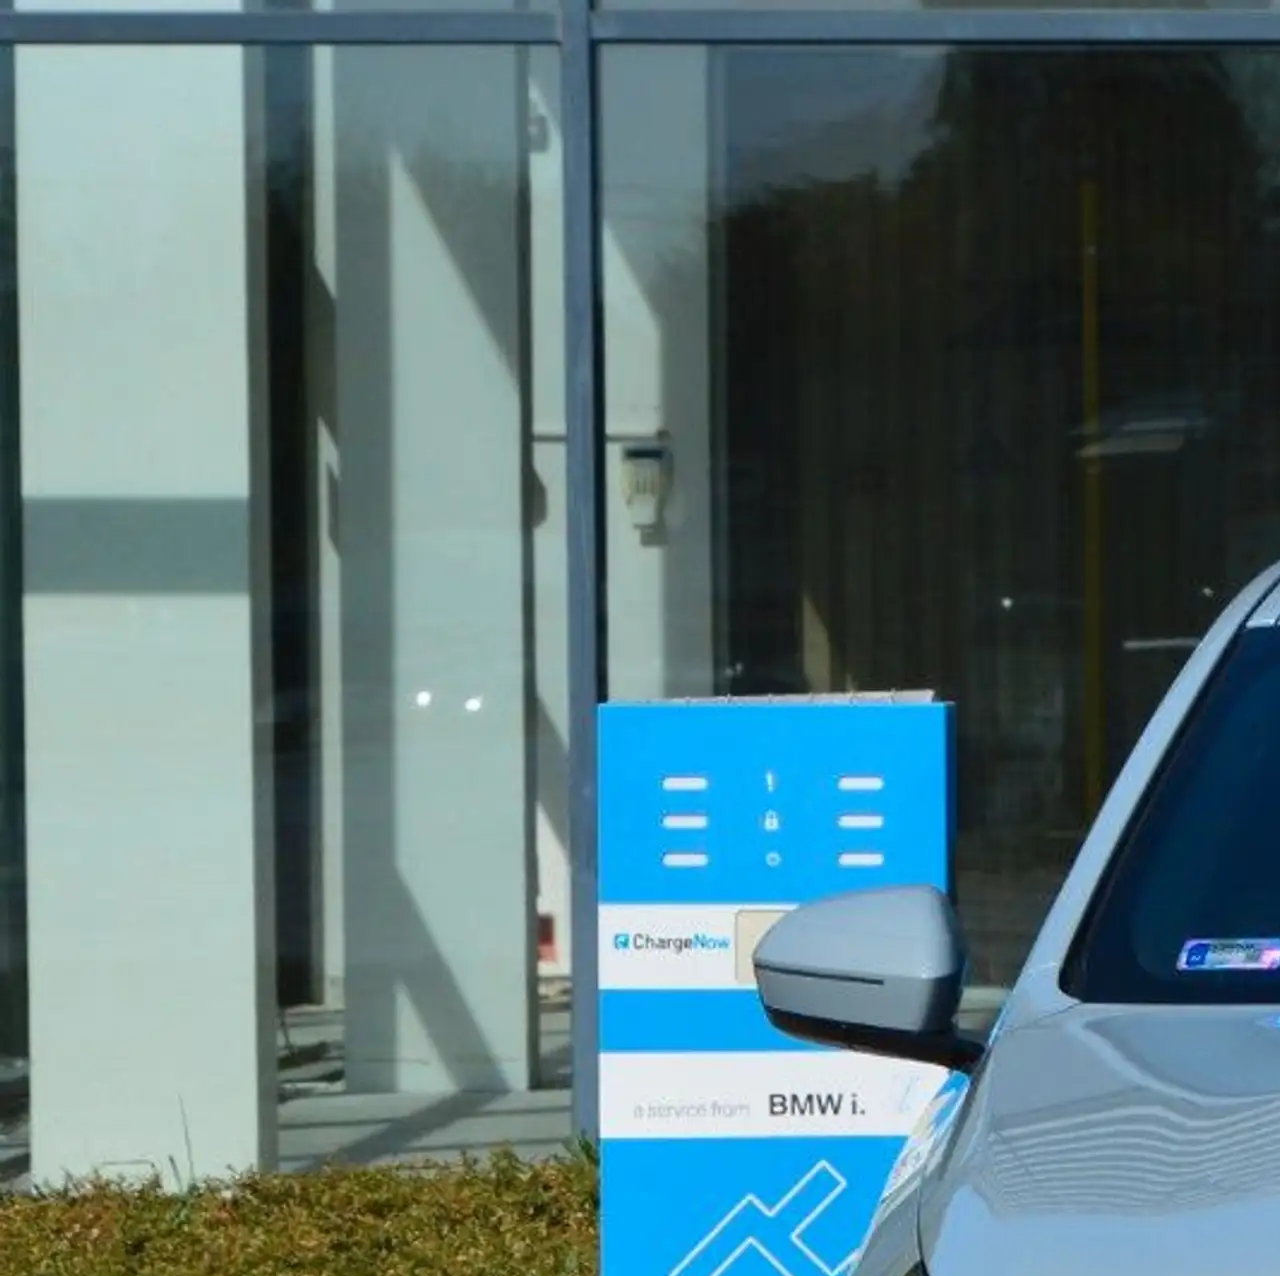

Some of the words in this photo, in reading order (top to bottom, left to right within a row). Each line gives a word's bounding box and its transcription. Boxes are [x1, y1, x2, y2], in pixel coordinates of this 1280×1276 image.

[633, 933, 729, 954] ChargeNow
[648, 1101, 707, 1118] service
[711, 1101, 750, 1118] from
[768, 1093, 843, 1116] BMW
